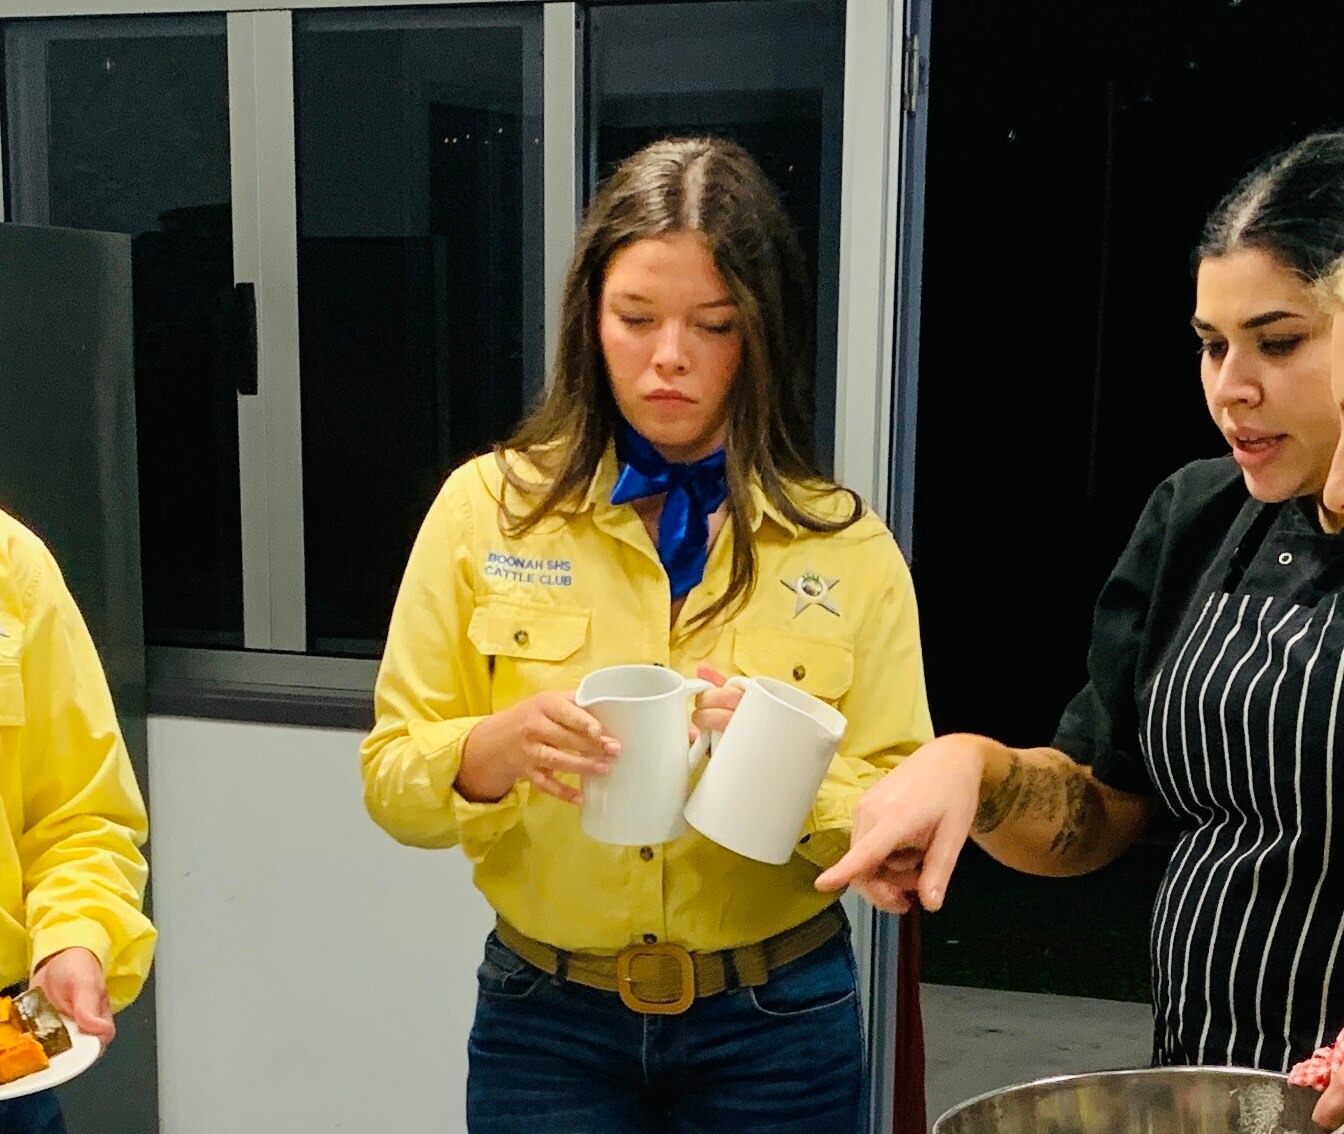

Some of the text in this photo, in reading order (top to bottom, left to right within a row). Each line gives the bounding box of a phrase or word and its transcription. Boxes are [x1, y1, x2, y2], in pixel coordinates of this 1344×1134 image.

[487, 552, 572, 571] BOONAH SHS
[485, 566, 572, 586] CATTLE CLUB
